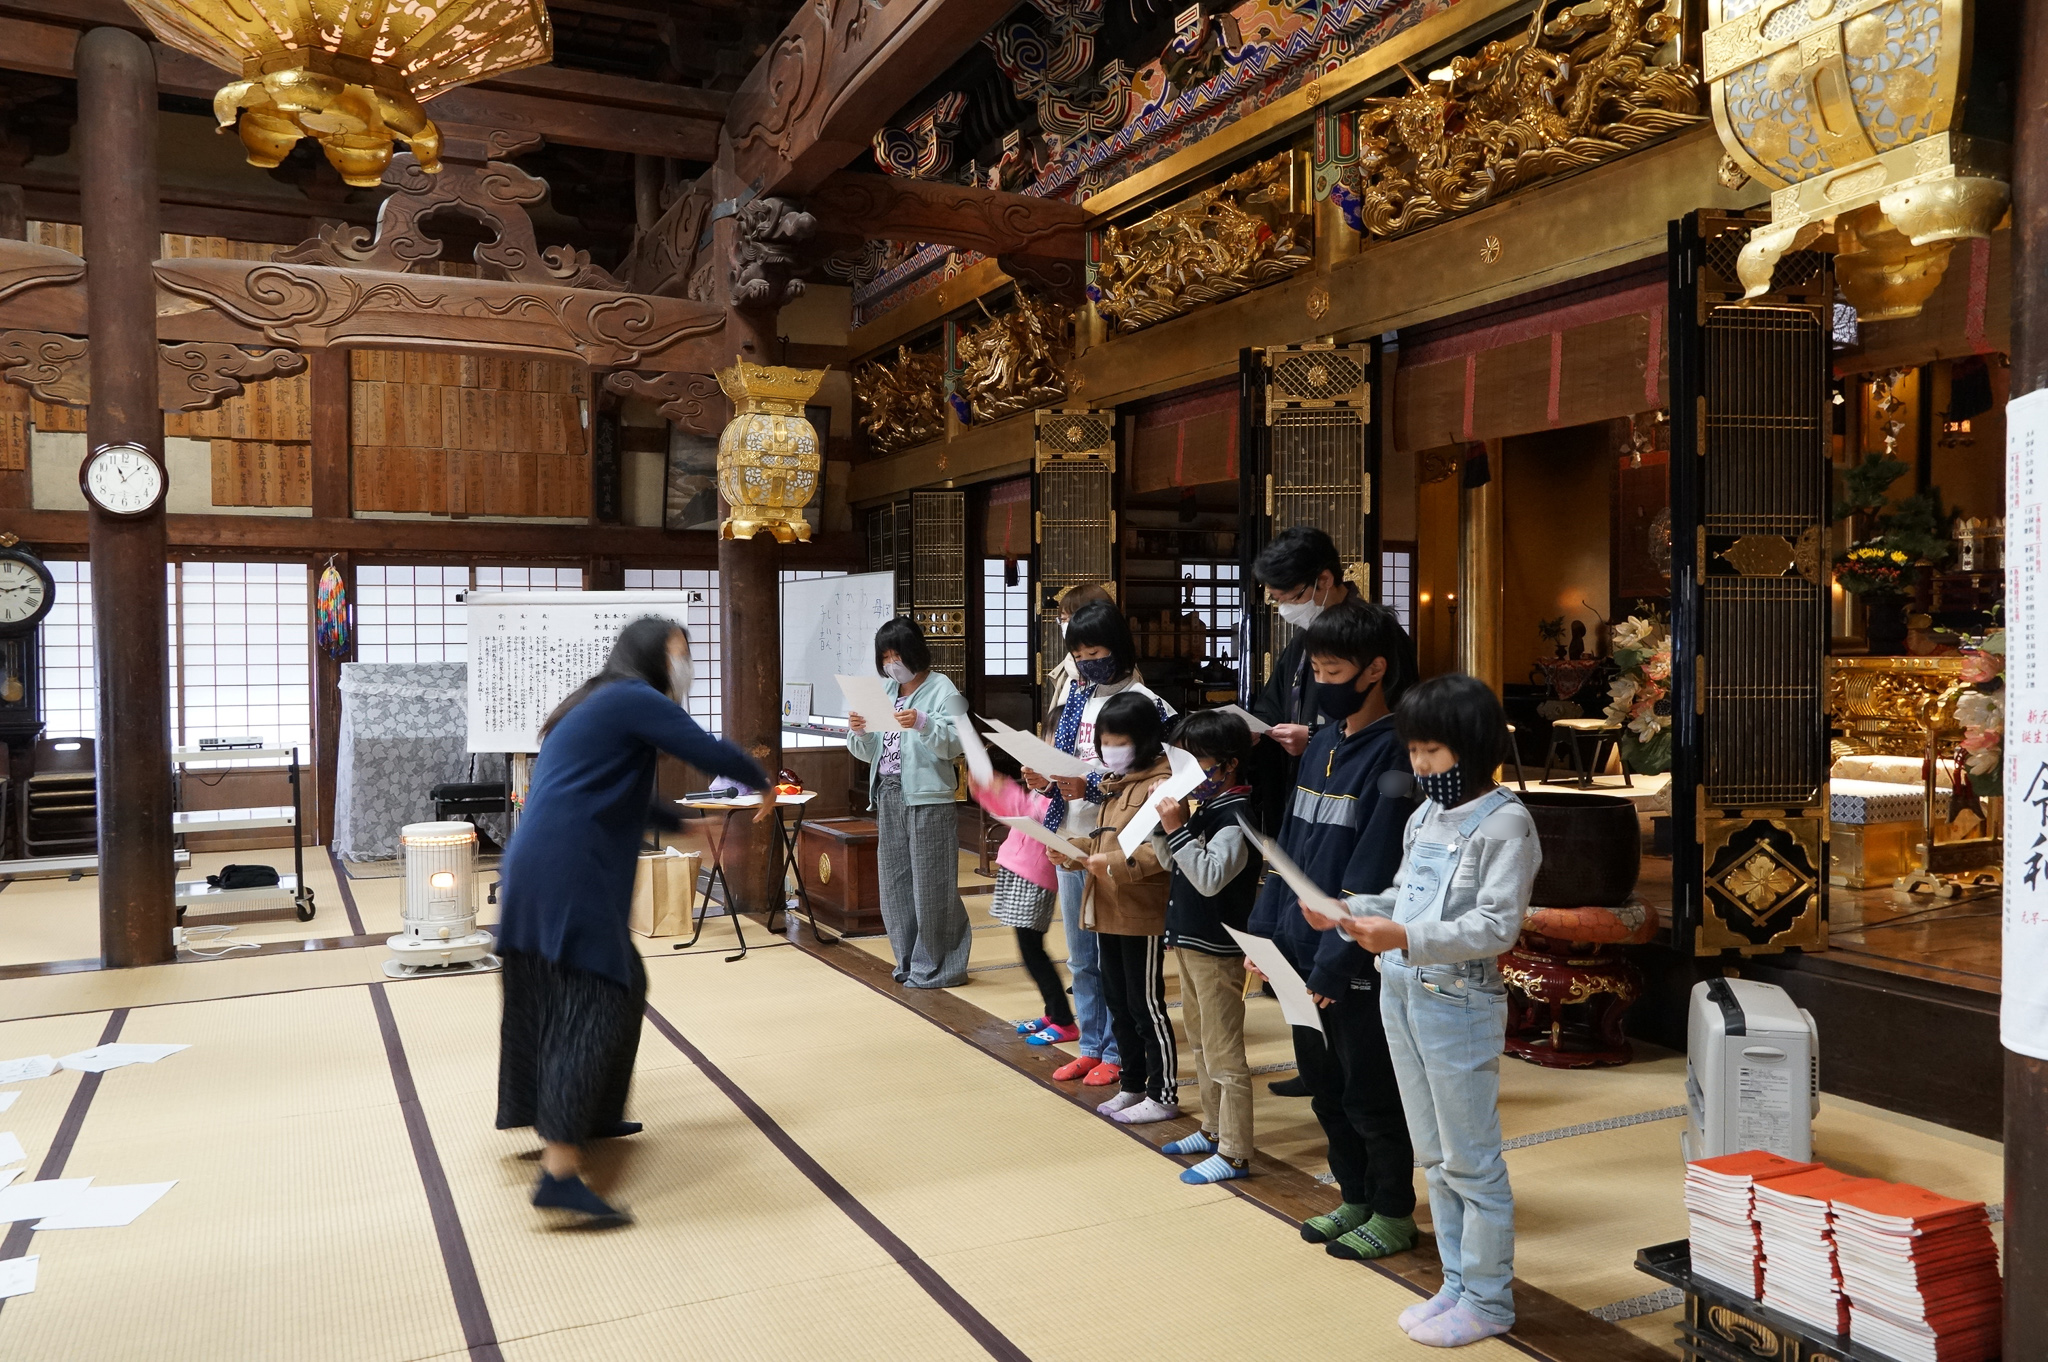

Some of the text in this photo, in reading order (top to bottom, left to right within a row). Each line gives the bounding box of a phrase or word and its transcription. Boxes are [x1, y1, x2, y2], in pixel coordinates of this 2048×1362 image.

[109, 455, 117, 465] 11
[121, 452, 130, 464] 12
[99, 462, 108, 472] 10
[143, 465, 150, 475] 2
[96, 474, 102, 483] 9
[148, 477, 154, 487] 3
[100, 485, 107, 495] 8
[144, 488, 149, 498] 4
[110, 493, 116, 504] 7
[121, 498, 128, 507] 6
[134, 495, 141, 505] 5
